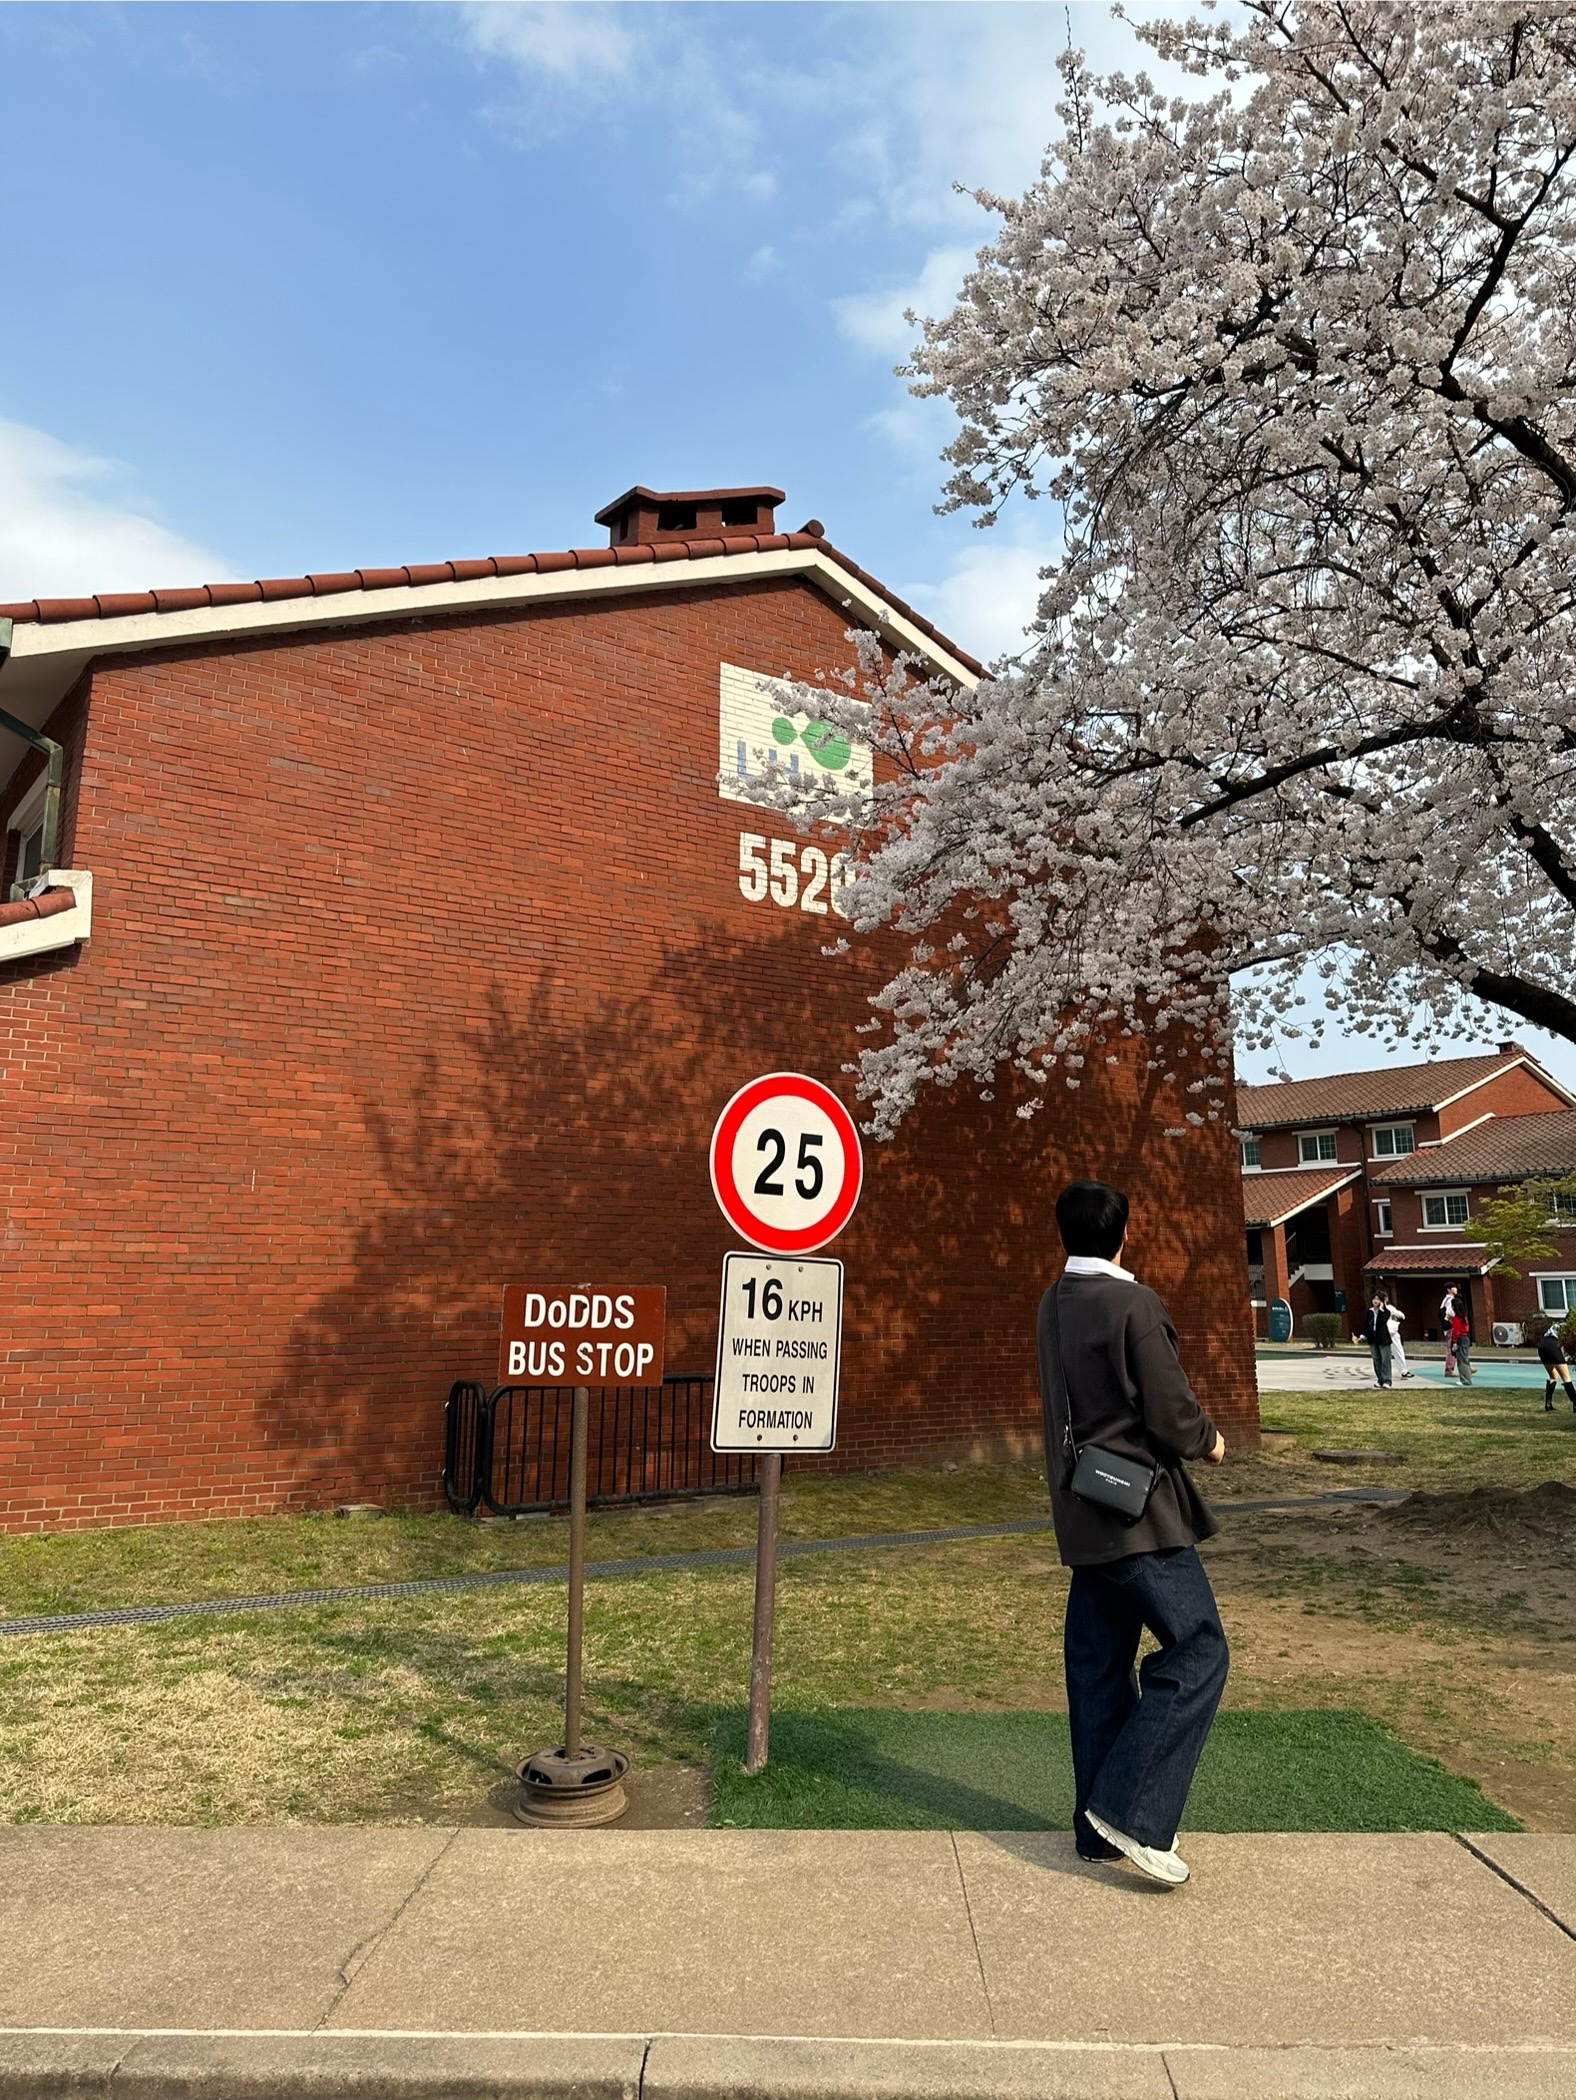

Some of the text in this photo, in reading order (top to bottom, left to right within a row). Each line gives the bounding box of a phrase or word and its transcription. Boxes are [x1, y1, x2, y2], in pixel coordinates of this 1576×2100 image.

[753, 1127, 825, 1201] 25
[524, 1293, 635, 1330] DoDDS
[741, 1277, 823, 1323] 16 KPH
[508, 1340, 654, 1378] BUS STOP
[732, 1337, 828, 1360] WHEN PASSING
[742, 1373, 815, 1394] TROOPS IN
[738, 1409, 813, 1430] FORMATION
